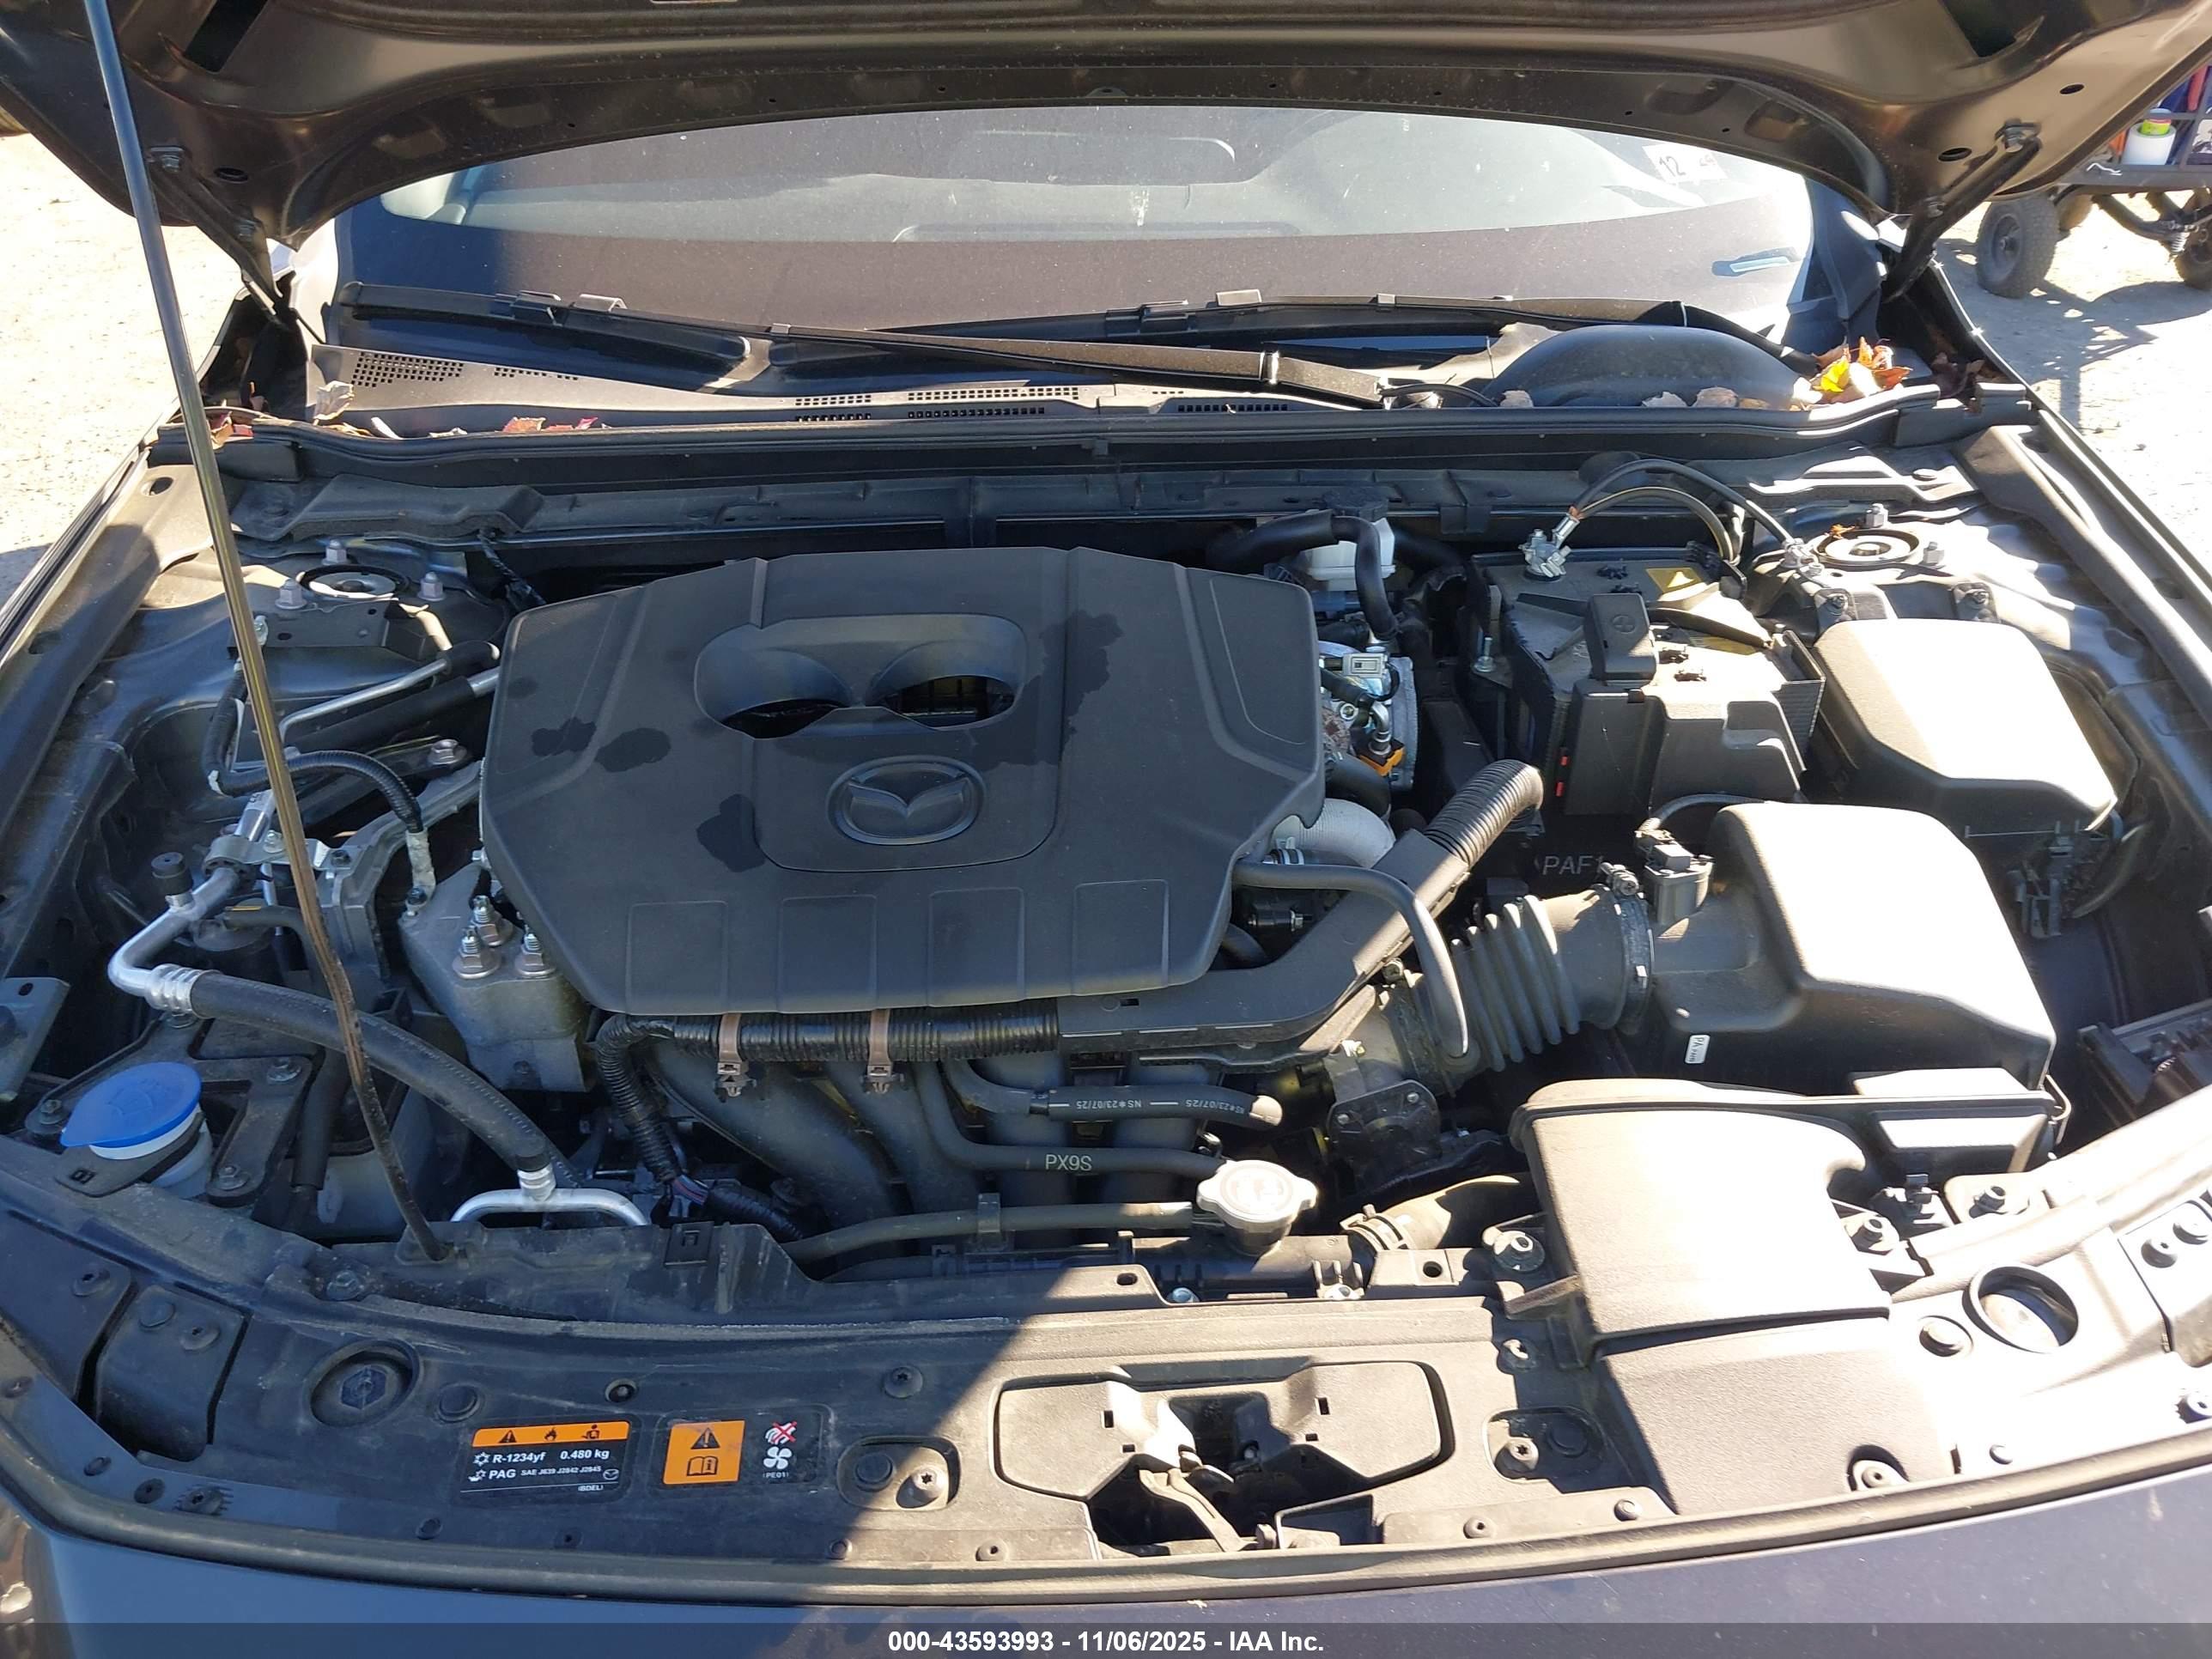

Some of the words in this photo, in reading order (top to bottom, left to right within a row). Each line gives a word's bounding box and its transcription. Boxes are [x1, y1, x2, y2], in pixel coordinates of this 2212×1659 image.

[1045, 1154, 1093, 1171] PX9S
[492, 1452, 546, 1463] R-1234yf
[560, 1449, 592, 1460] 0.480
[594, 1449, 611, 1460] kg
[489, 1469, 516, 1480] PAG
